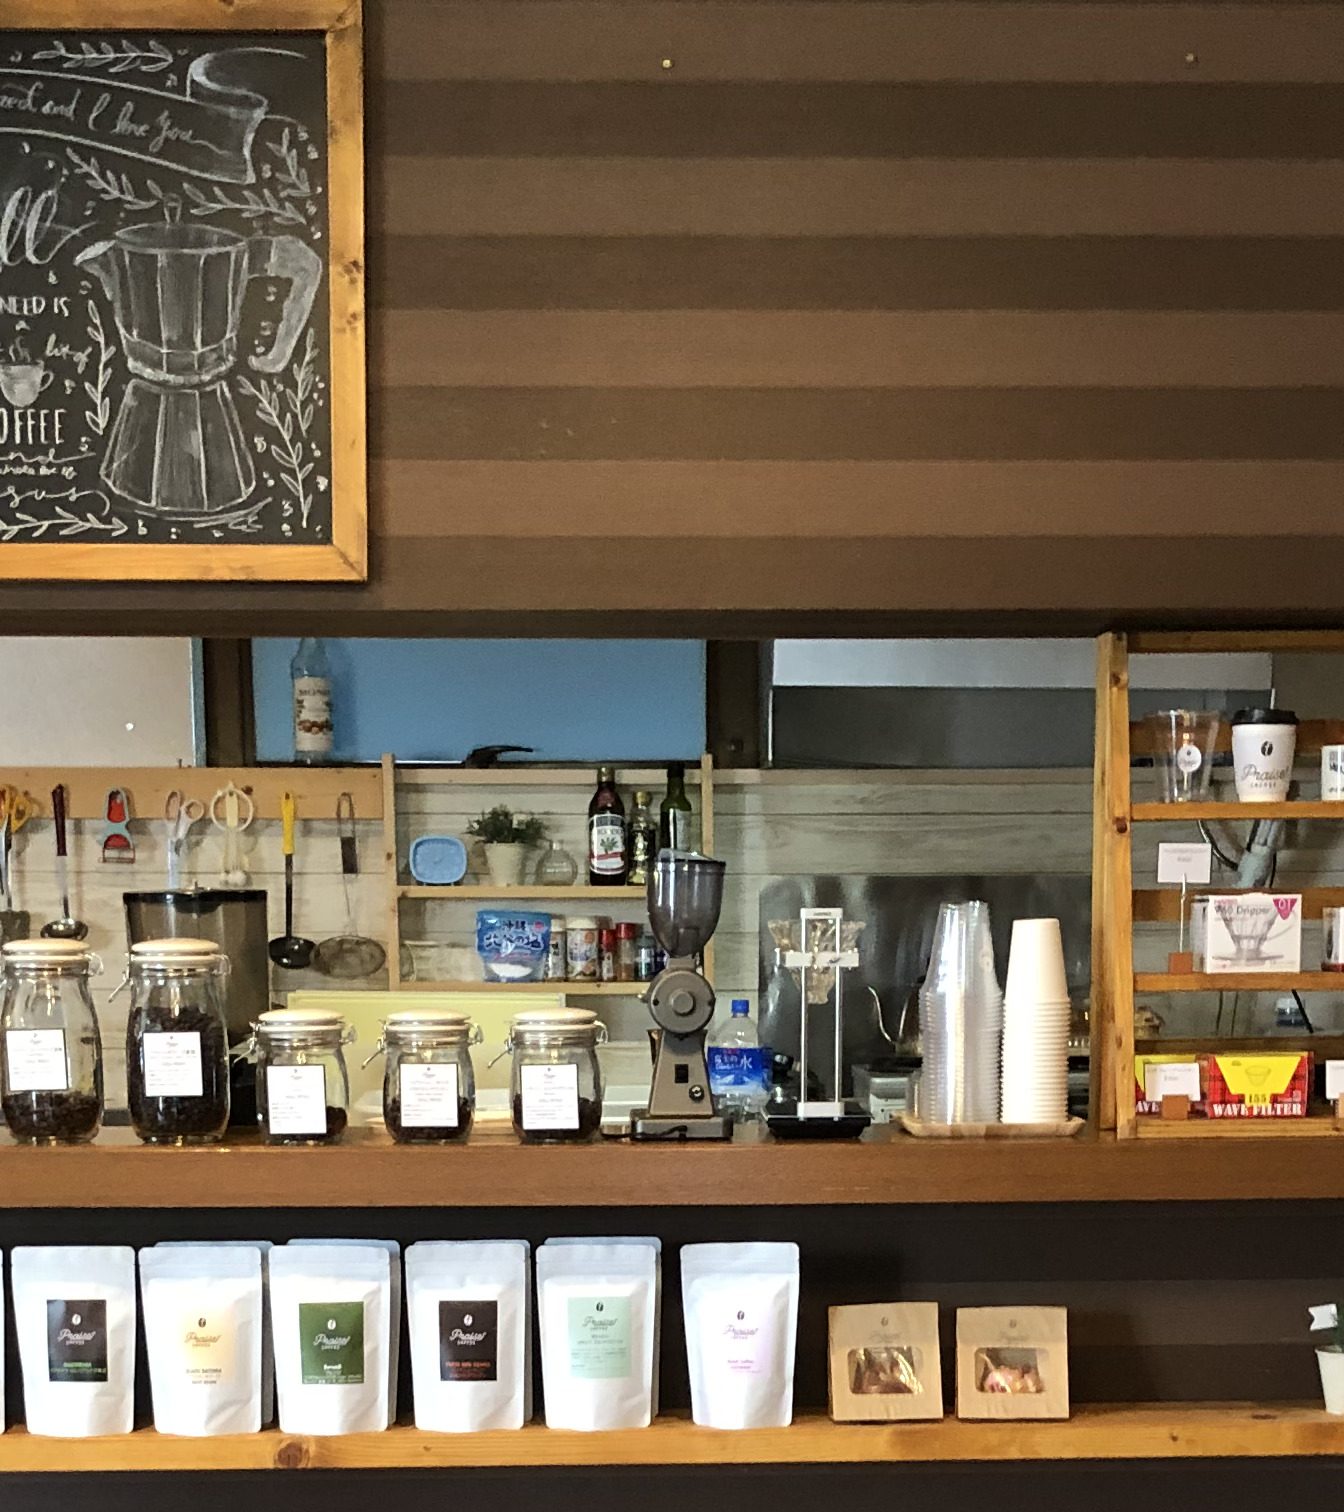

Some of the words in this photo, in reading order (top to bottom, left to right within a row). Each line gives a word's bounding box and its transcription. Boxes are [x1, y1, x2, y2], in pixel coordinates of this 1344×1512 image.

[1241, 763, 1288, 781] Praise
[1236, 905, 1270, 917] Dripper
[1253, 1103, 1302, 1116] FILTER
